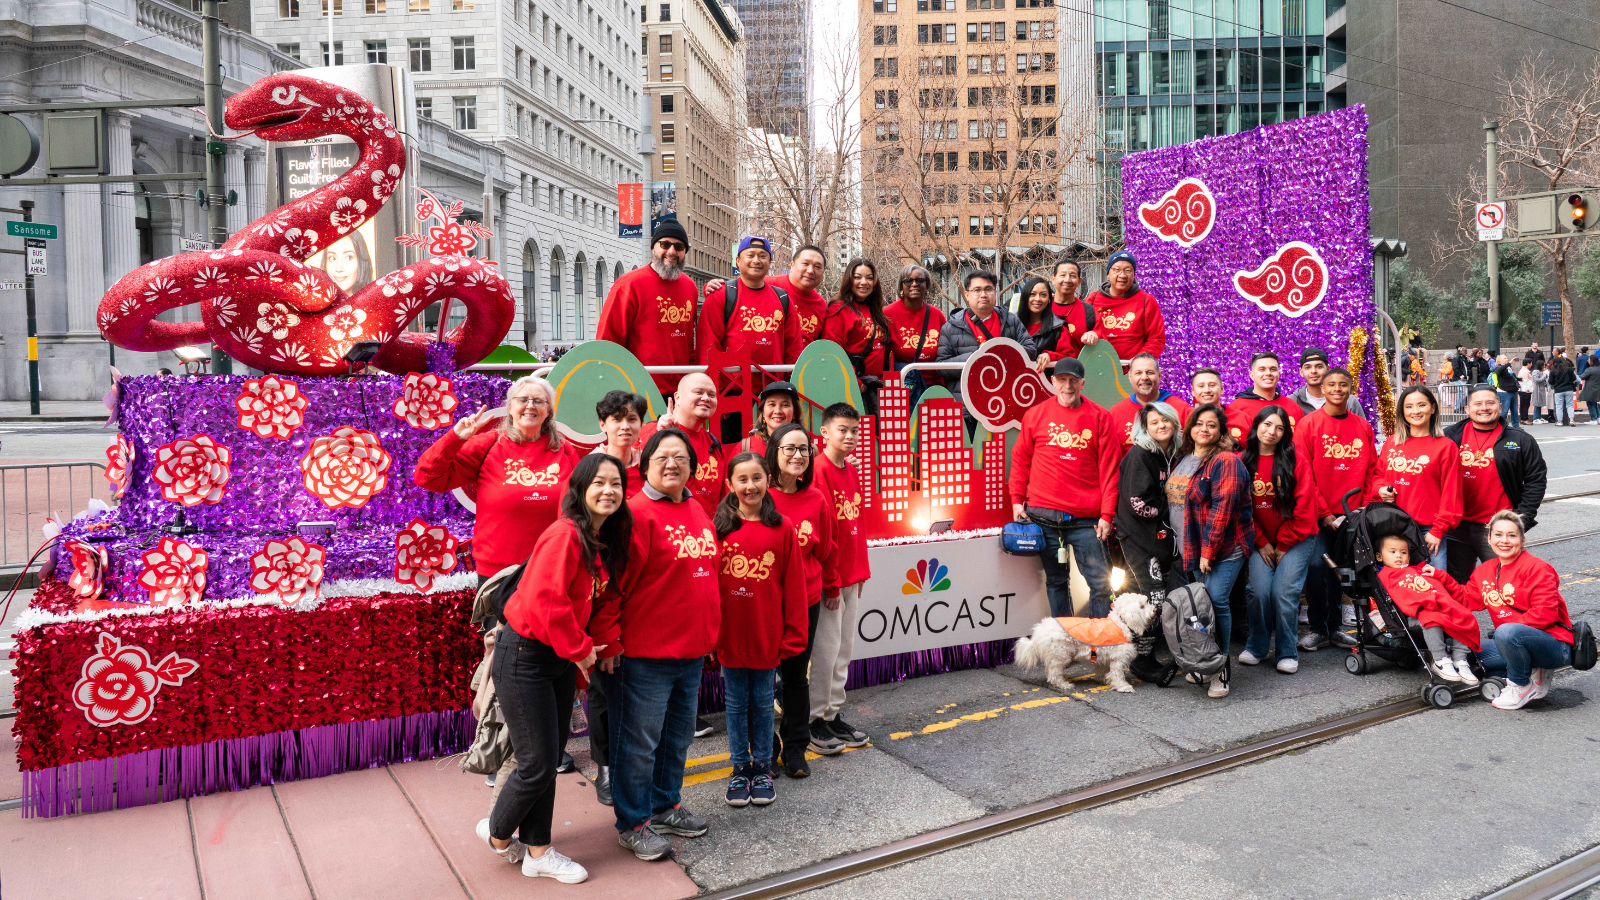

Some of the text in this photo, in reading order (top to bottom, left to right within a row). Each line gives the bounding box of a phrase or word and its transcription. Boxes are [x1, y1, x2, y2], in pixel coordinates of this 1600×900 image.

[289, 157, 352, 170] Flavor Filled.
[289, 172, 338, 184] Guilt Free
[14, 224, 51, 236] Sansome
[32, 249, 43, 257] BUS
[185, 240, 209, 251] SANSOME
[30, 266, 47, 274] AHEAD
[660, 305, 692, 324] 2025
[1102, 315, 1131, 329] 025
[743, 315, 780, 333] 2025
[1048, 431, 1088, 449] 2025
[1323, 443, 1361, 459] 2025
[695, 462, 719, 481] 025
[1387, 456, 1423, 474] 2025
[505, 467, 559, 487] 2025
[673, 534, 717, 559] 2025
[692, 570, 710, 578] COMCAST
[721, 554, 771, 580] 2025
[730, 589, 755, 598] COMCAST
[857, 592, 1017, 643] OMCAST
